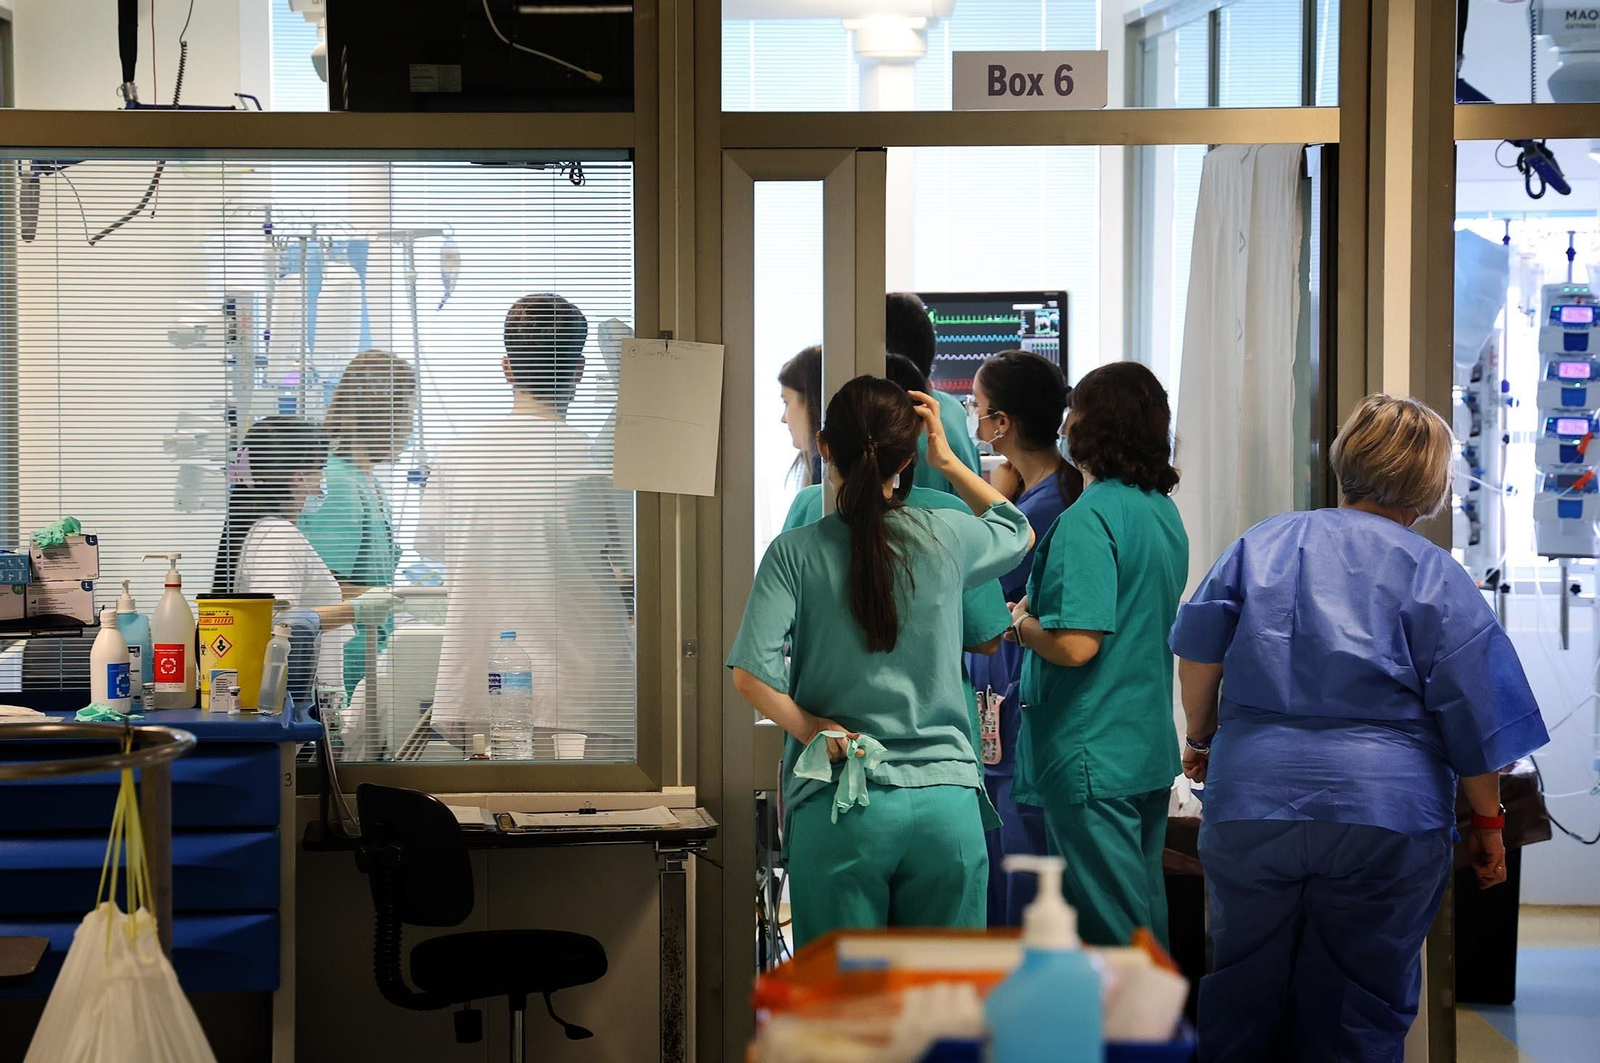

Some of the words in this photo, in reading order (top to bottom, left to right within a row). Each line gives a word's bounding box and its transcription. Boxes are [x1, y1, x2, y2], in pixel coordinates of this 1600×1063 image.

[988, 65, 1044, 96] Box
[1054, 64, 1074, 96] 6
[284, 772, 292, 787] 3
